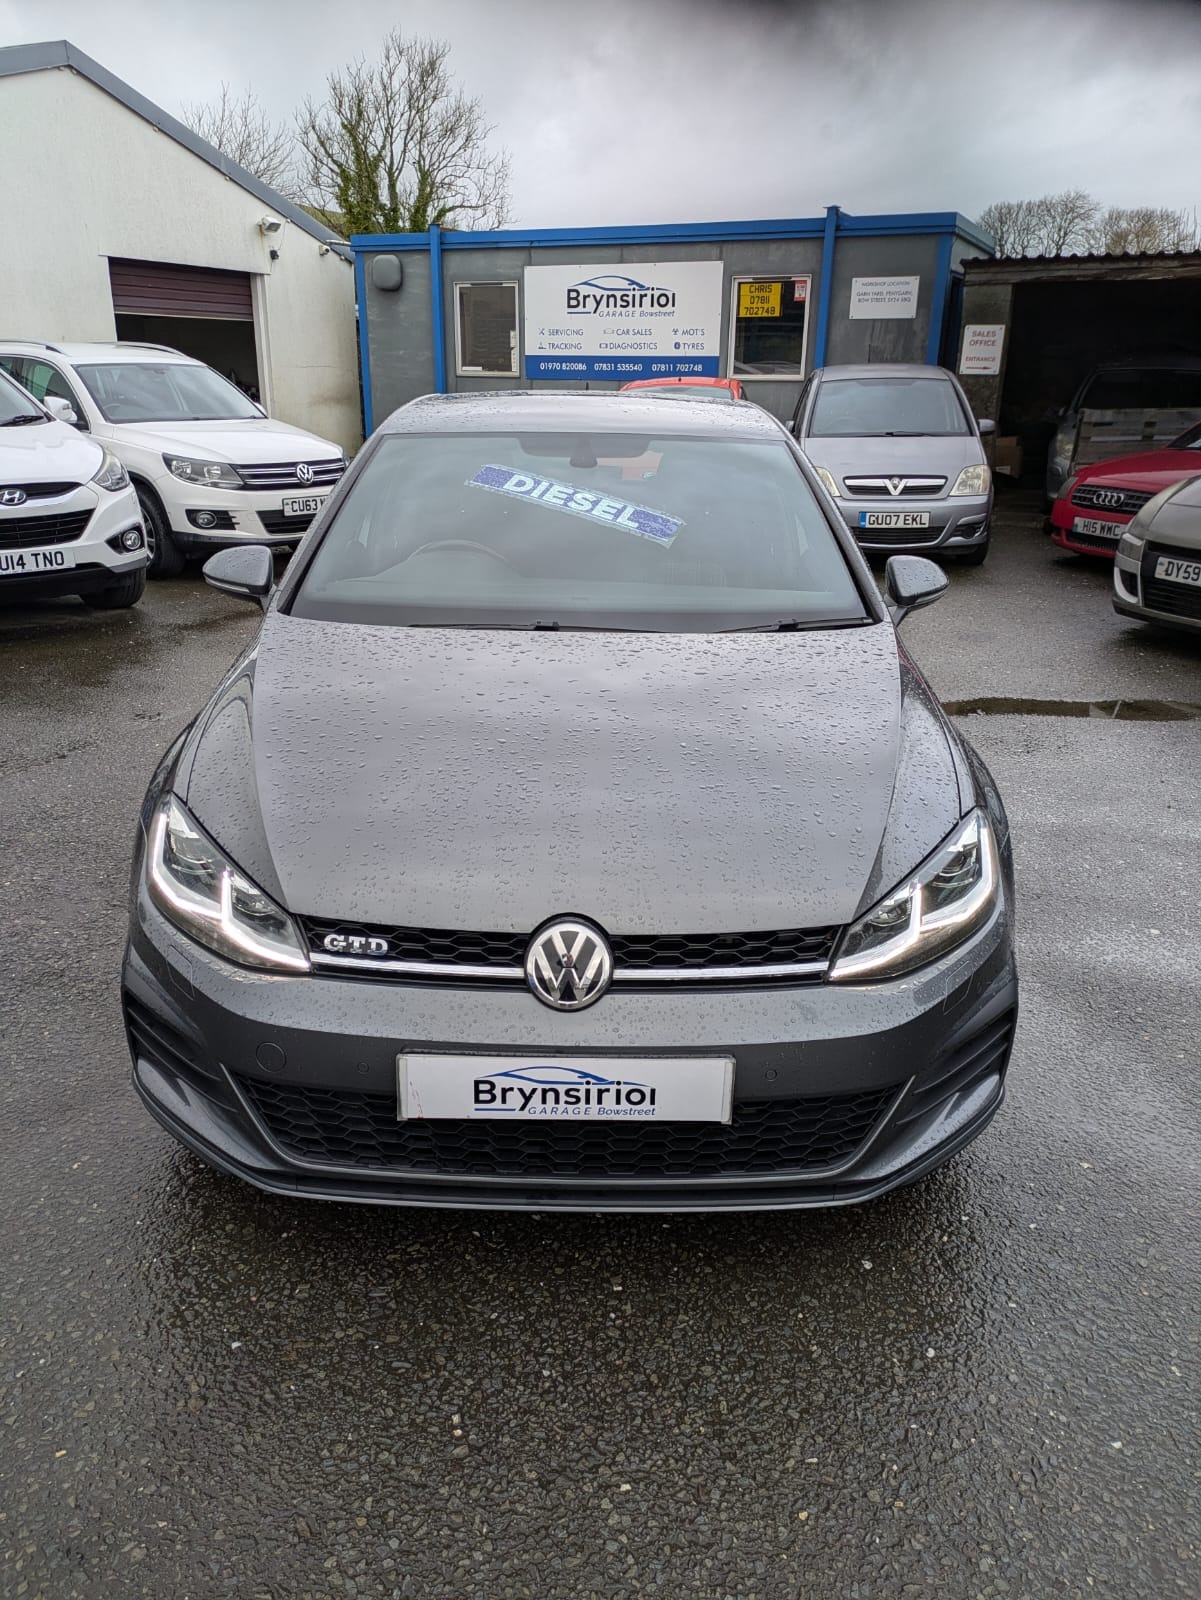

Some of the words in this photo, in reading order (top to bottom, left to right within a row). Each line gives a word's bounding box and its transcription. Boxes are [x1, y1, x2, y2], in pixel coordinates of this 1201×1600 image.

[749, 285, 773, 293] CHRIS
[567, 288, 675, 314] Brynsiriol
[750, 296, 770, 304] 07811
[598, 310, 636, 318] GARAGE
[639, 309, 675, 318] Bowstreet
[744, 307, 776, 315] 702748
[548, 328, 584, 336] SERVICING
[616, 328, 631, 336] CAR
[632, 328, 652, 336] SALES
[681, 328, 705, 336] MOT'S
[547, 342, 583, 350] TRACKING
[609, 342, 658, 350] DIAGNOSTICS
[682, 342, 705, 350] TYRES
[969, 339, 997, 347] OFFICE
[540, 362, 561, 371] 01970
[561, 362, 587, 371] 820086
[594, 363, 615, 371] 07831
[616, 363, 643, 371] 535540
[652, 363, 673, 372] 07811
[675, 364, 703, 372] 702748
[291, 499, 318, 512] CU63
[503, 474, 639, 529] DIESEL
[868, 514, 900, 525] GU07
[903, 514, 927, 525] EKL
[31, 551, 65, 568] TNO
[1164, 560, 1201, 582] DY59
[324, 933, 389, 955] GTD
[474, 1080, 656, 1110] Brynsiriol
[528, 1106, 591, 1116] GARAGE
[597, 1106, 656, 1116] Bowstreet
